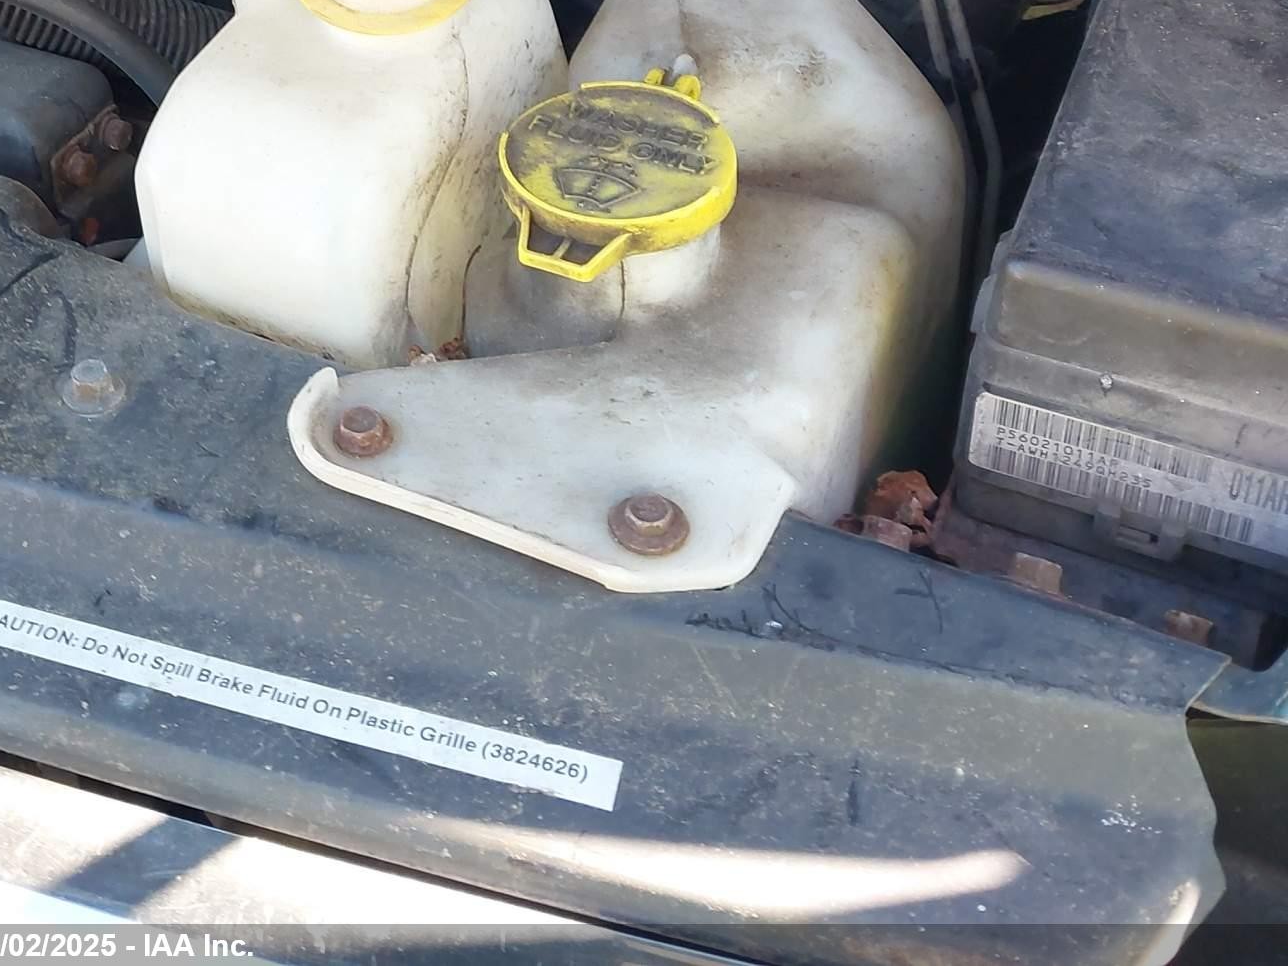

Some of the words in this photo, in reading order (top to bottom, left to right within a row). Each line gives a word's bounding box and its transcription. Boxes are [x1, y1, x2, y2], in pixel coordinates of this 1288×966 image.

[528, 114, 624, 153] FLUID
[630, 141, 718, 175] ONLY
[569, 97, 709, 152] WASHER
[82, 636, 109, 655] Do
[113, 644, 147, 667] Not
[150, 656, 193, 679] Spill
[197, 668, 253, 695] Brake
[258, 683, 310, 710] Fluid
[312, 698, 343, 719] On
[346, 707, 415, 738] Plastic
[419, 726, 477, 753] Grille
[481, 740, 589, 784] (3824626)
